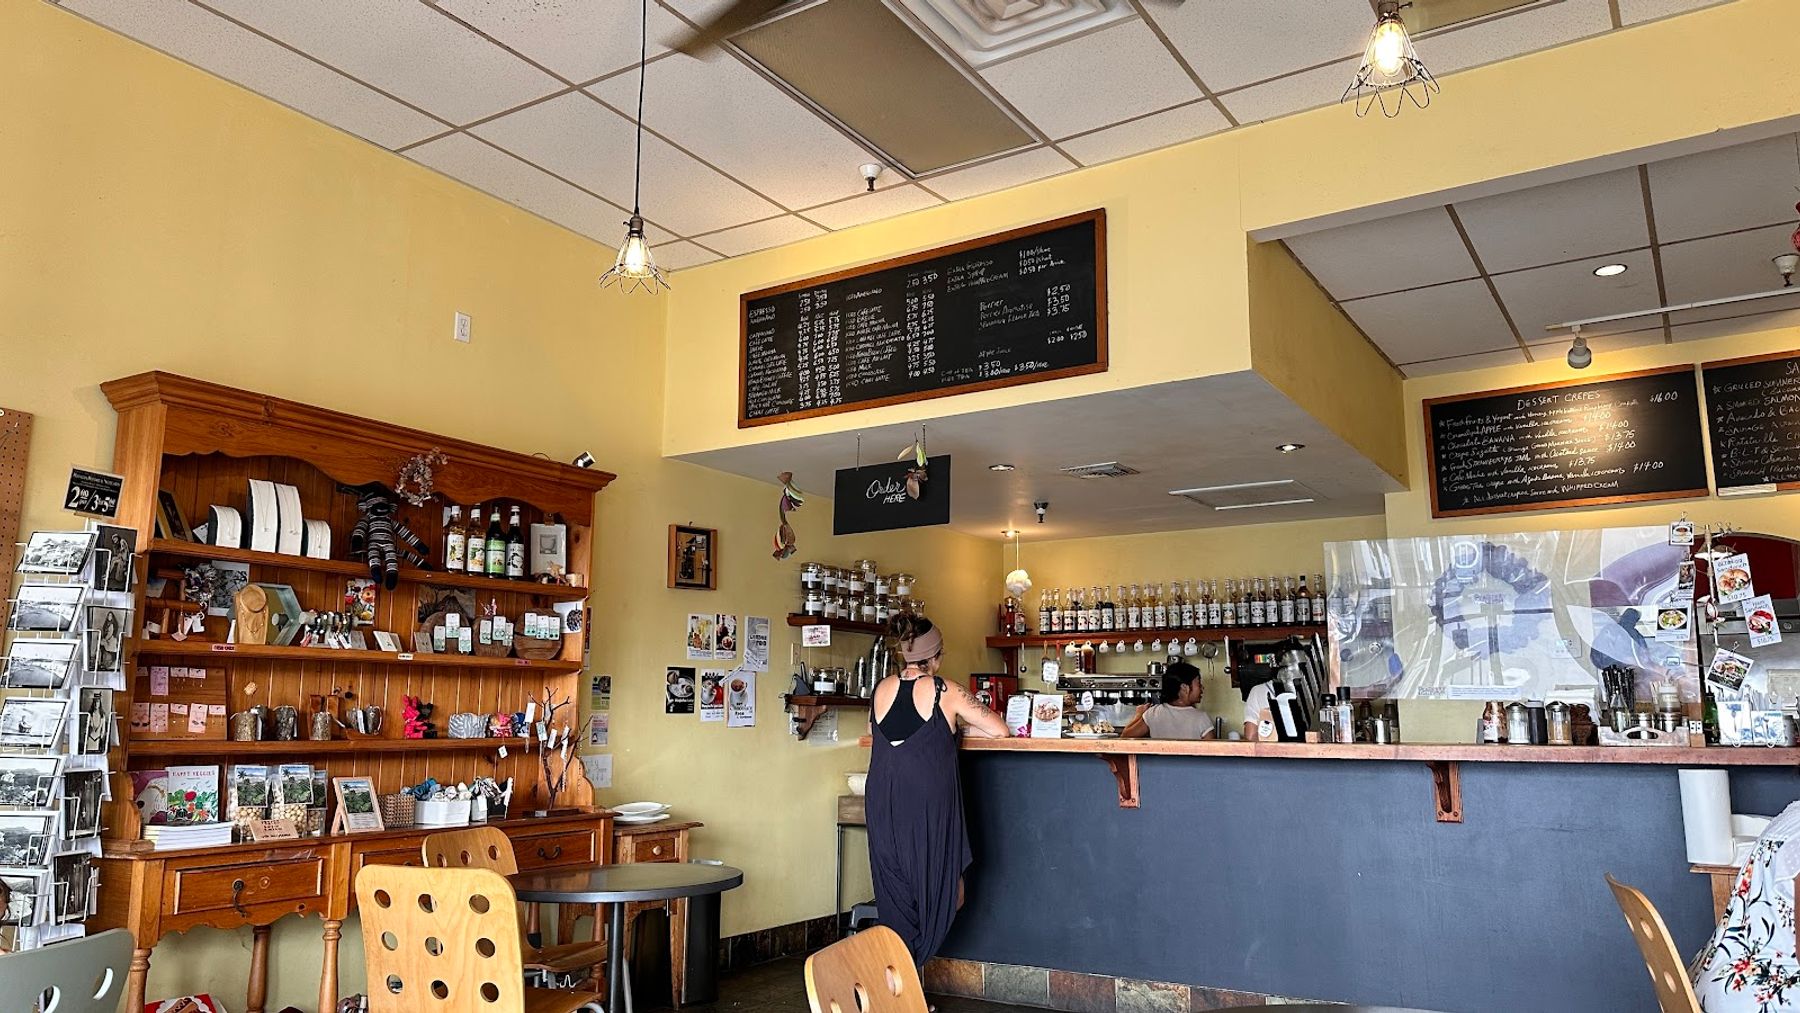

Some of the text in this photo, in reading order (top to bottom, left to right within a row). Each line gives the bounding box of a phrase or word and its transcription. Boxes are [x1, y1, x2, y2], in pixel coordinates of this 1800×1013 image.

[1517, 395, 1559, 411] DESSERT
[1563, 389, 1601, 402] CREPES
[866, 477, 906, 499] Order
[882, 493, 907, 504] HERE
